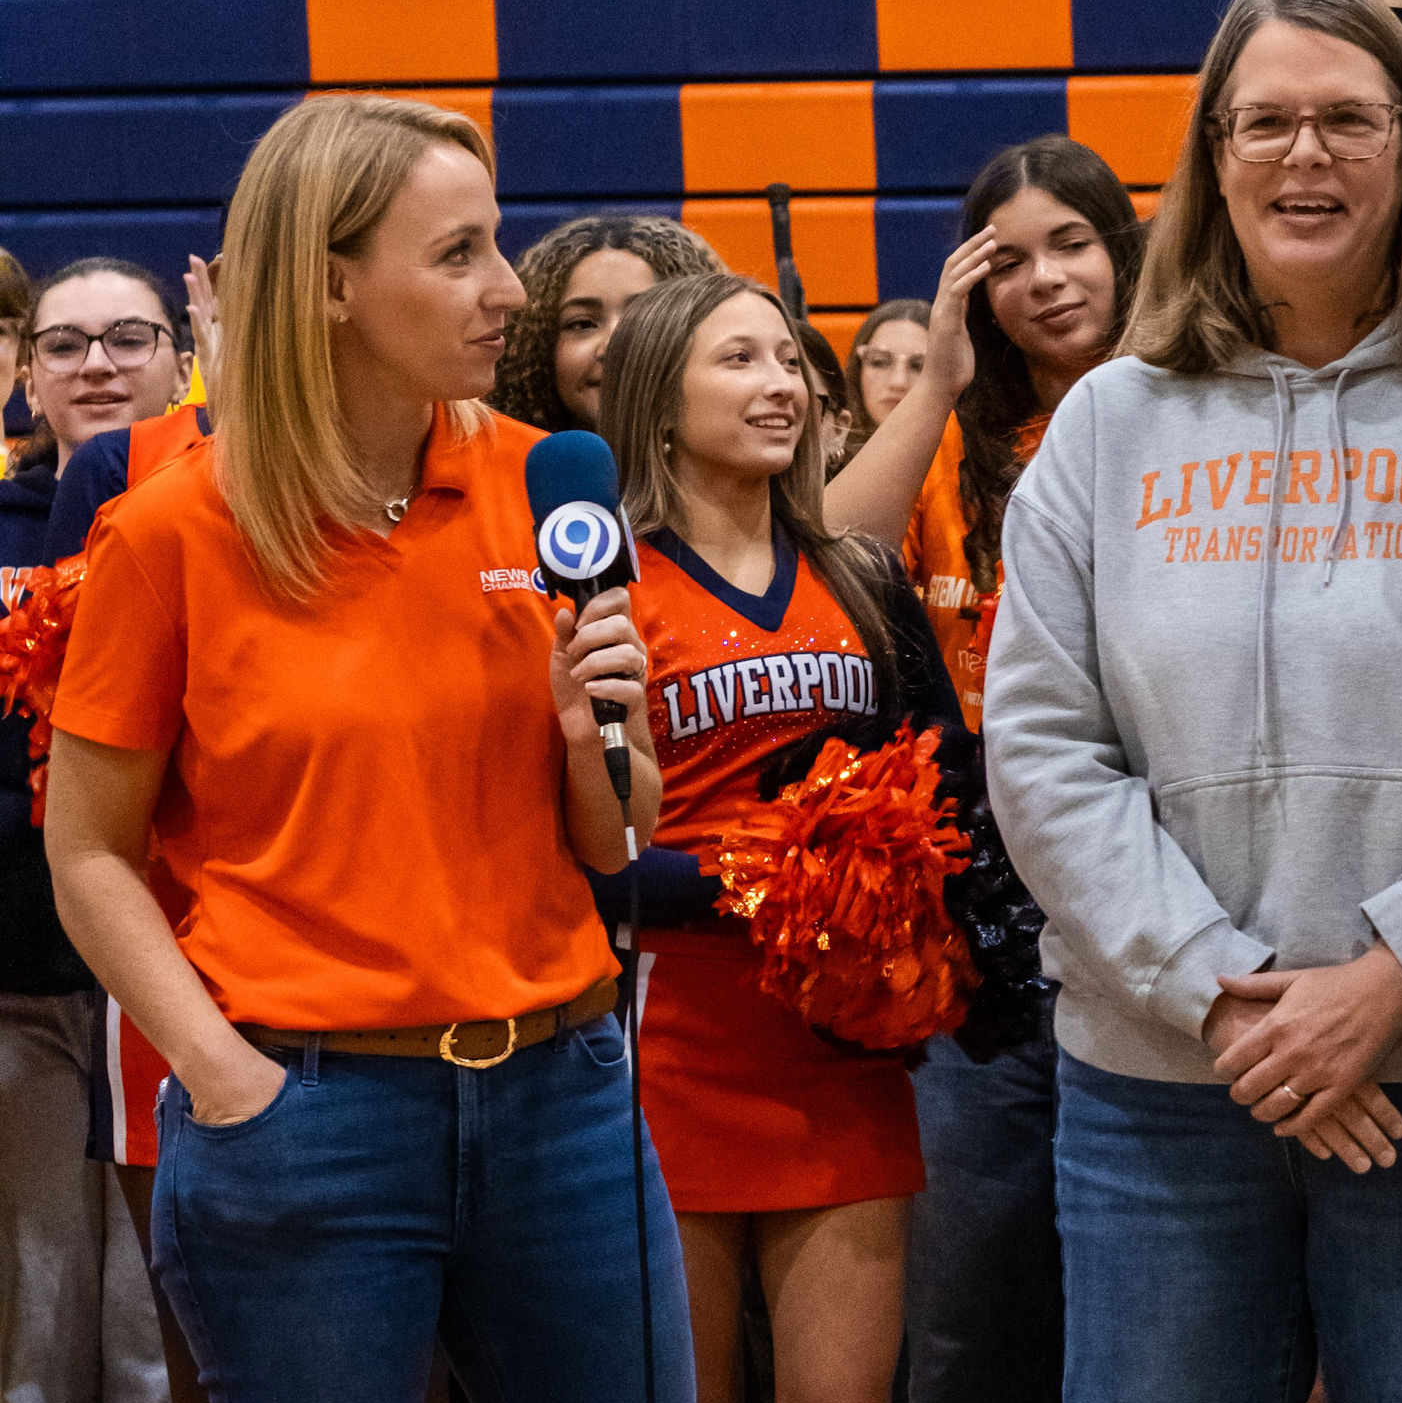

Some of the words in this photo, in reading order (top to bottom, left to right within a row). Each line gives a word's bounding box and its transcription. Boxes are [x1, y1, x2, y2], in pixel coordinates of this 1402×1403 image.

[480, 568, 530, 584] NEWS
[549, 510, 610, 579] 9
[663, 653, 878, 741] LIVERPOOL
